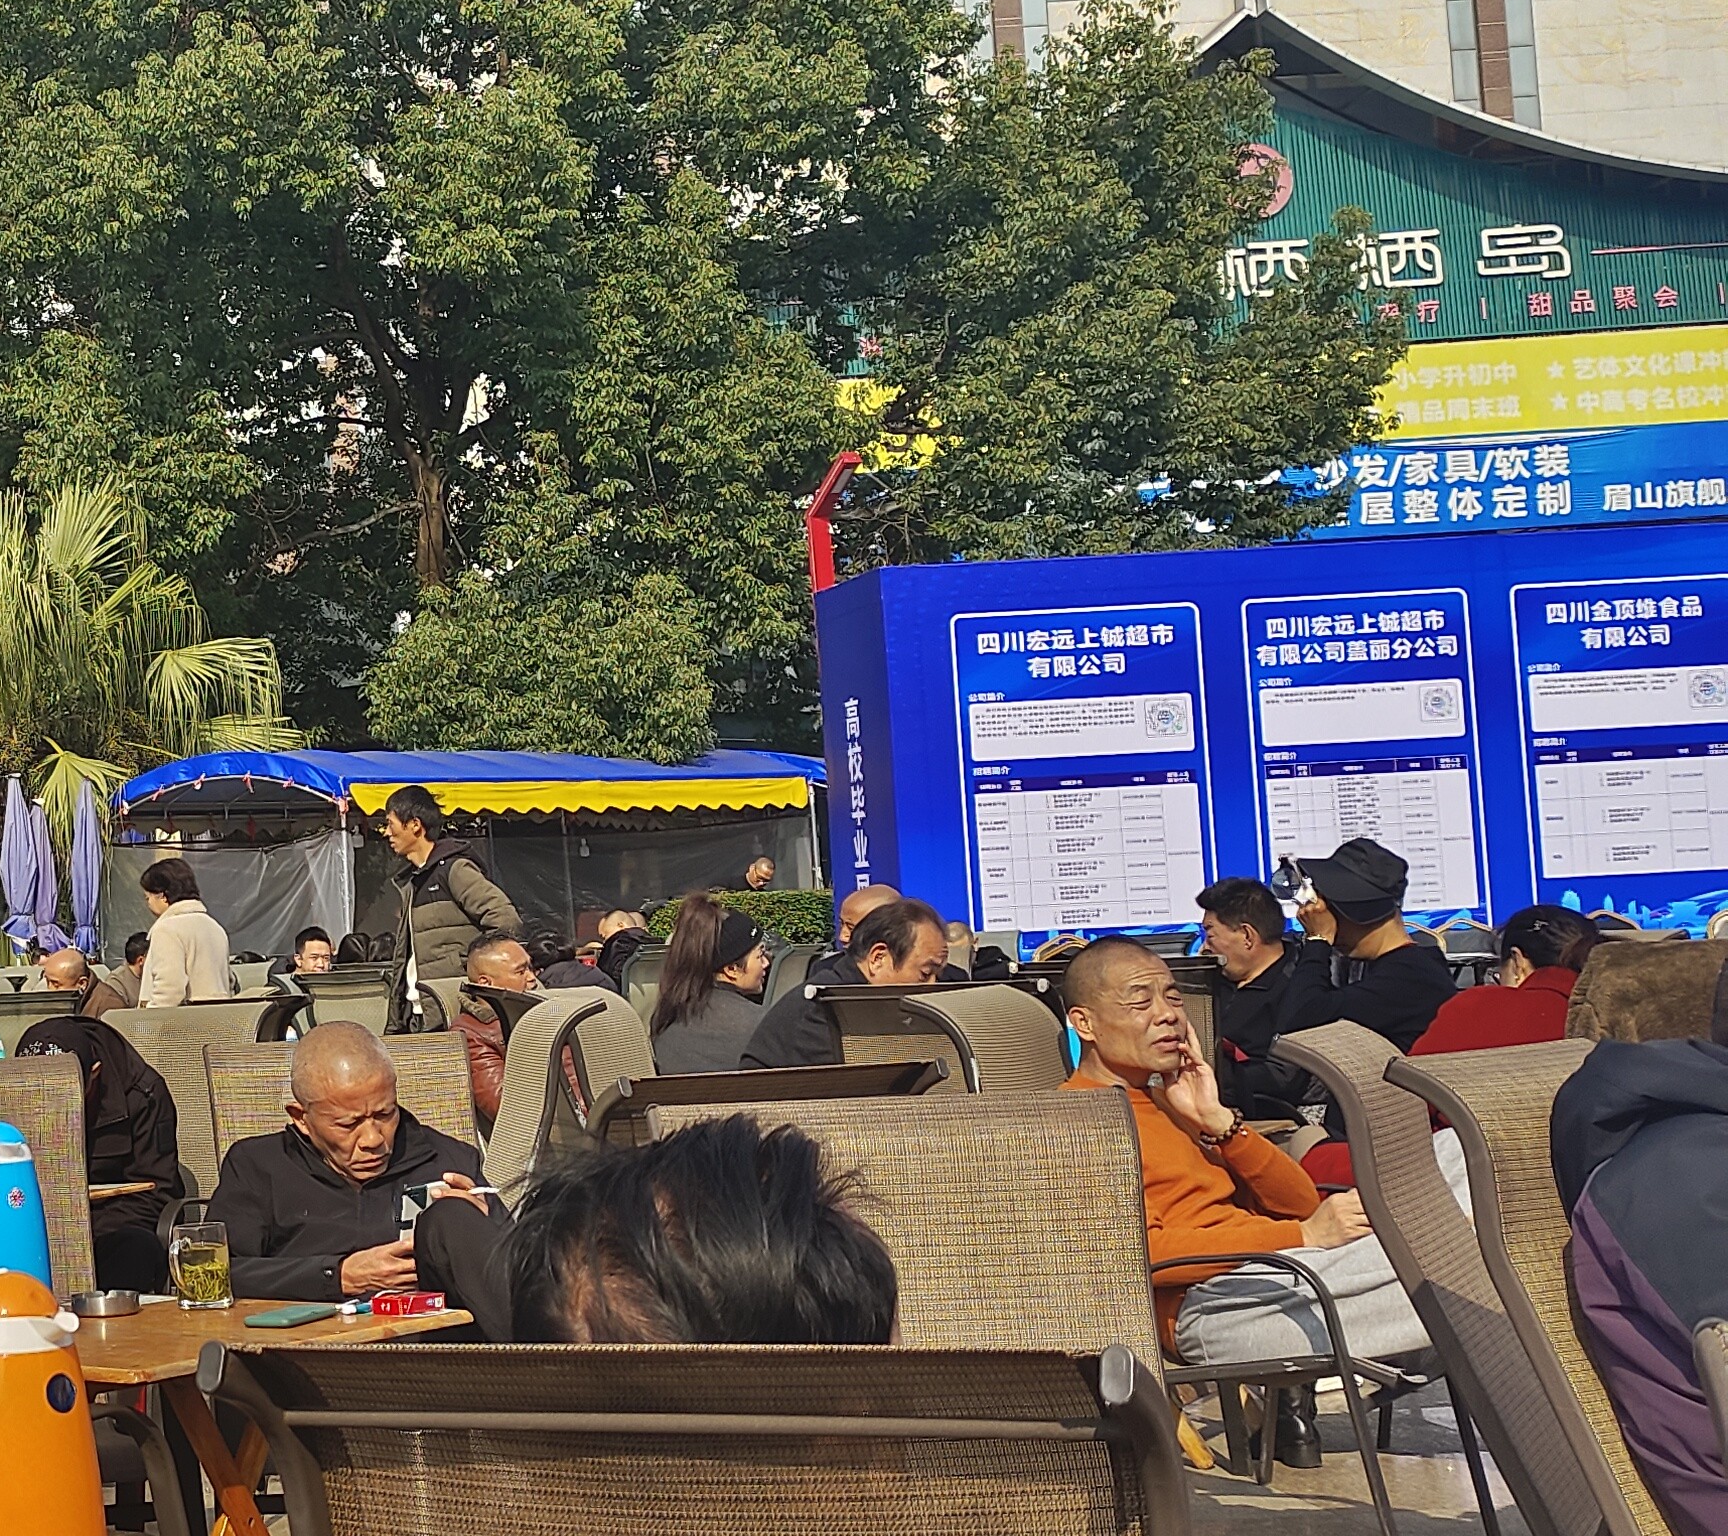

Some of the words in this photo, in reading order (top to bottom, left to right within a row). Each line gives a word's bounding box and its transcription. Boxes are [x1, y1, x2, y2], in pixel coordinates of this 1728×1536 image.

[1527, 285, 1680, 318] 甜品聚会
[1394, 360, 1518, 392] 小学升初中
[1574, 349, 1728, 381] 艺体文化课冲
[1576, 384, 1728, 414] 中高考名校冲
[1312, 444, 1571, 492] 沙发/家具/软装
[1319, 480, 1572, 527] 屋整体定制
[1602, 478, 1727, 512] 眉山旗舰
[1579, 624, 1671, 650] 有限公司
[1026, 652, 1126, 679] 有限公司
